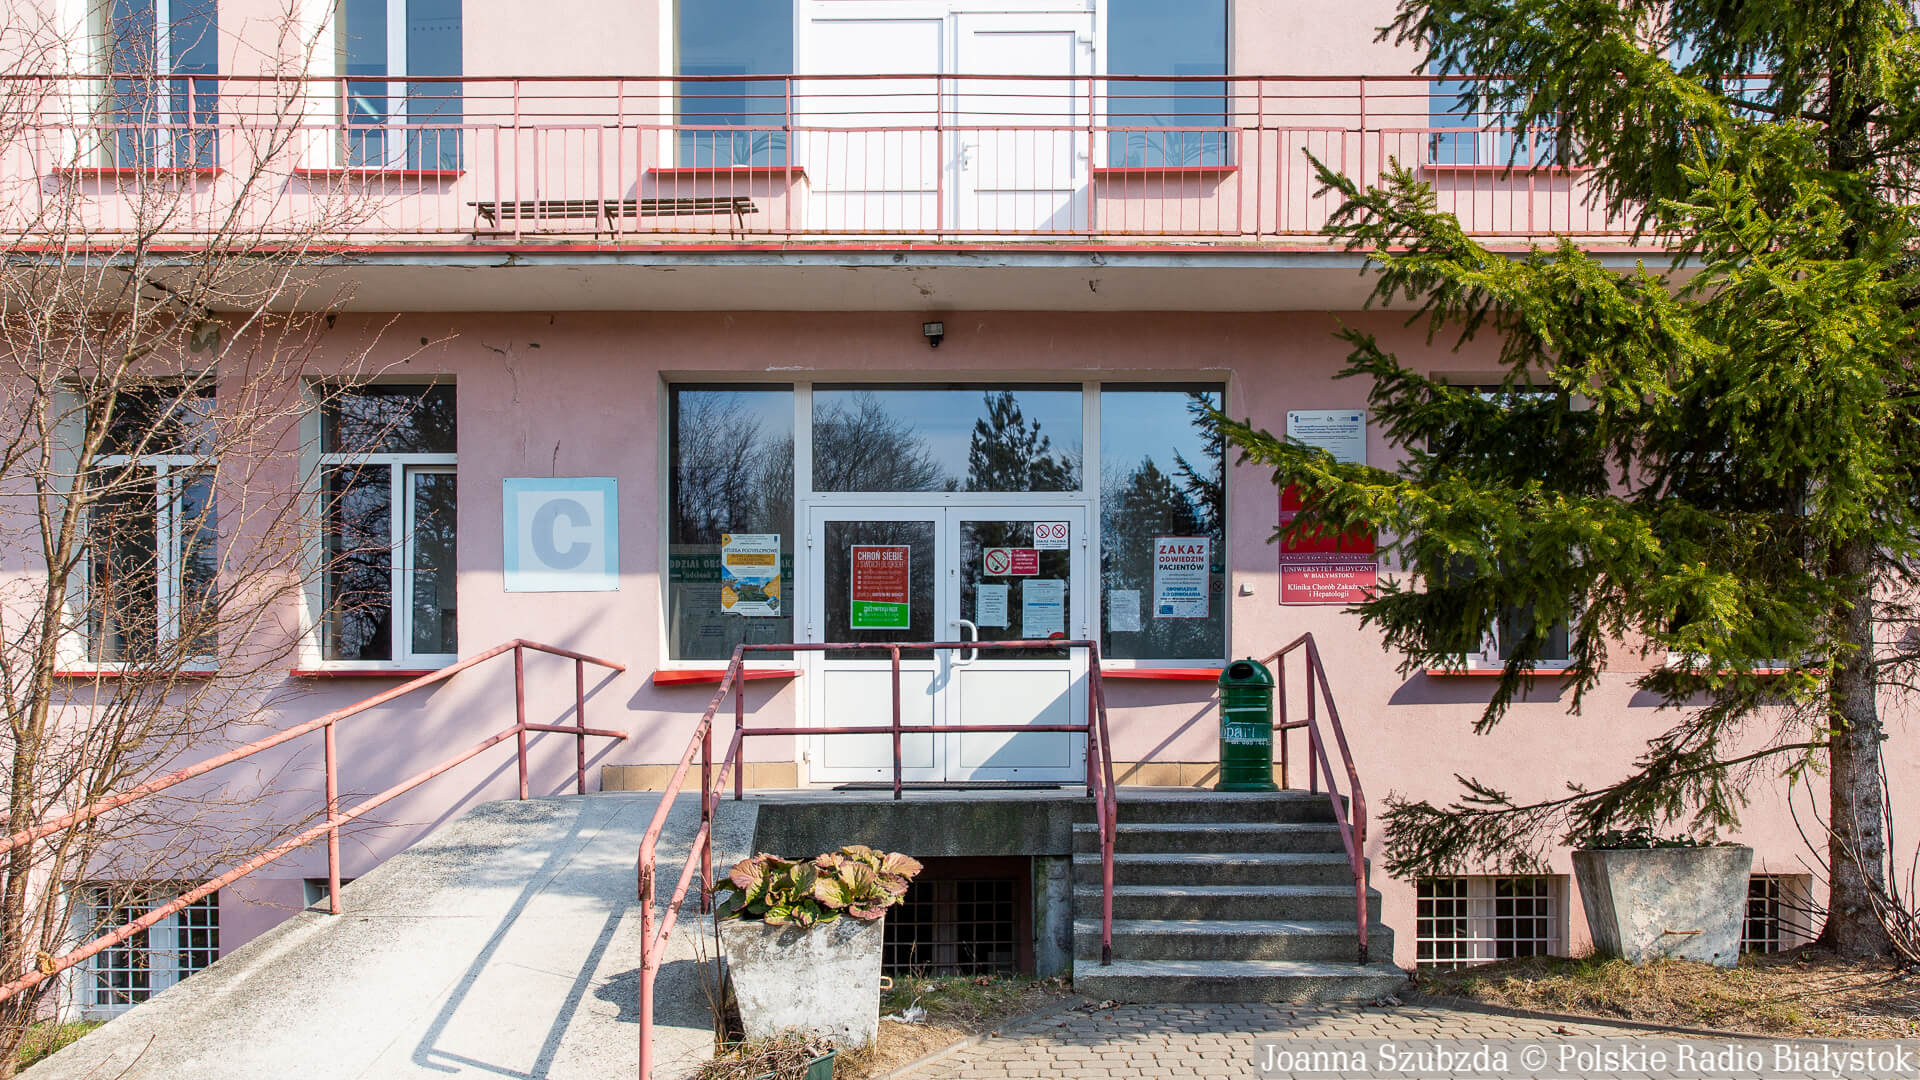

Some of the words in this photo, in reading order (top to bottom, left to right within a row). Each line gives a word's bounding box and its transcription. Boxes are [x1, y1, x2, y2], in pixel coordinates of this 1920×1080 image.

[531, 498, 593, 570] C
[1159, 544, 1204, 554] ZAKAZ
[857, 549, 880, 560] CHROŃ
[882, 551, 903, 560] SIEBIE
[1159, 563, 1204, 571] PACJENTÓW
[1313, 590, 1349, 598] Hepatologii
